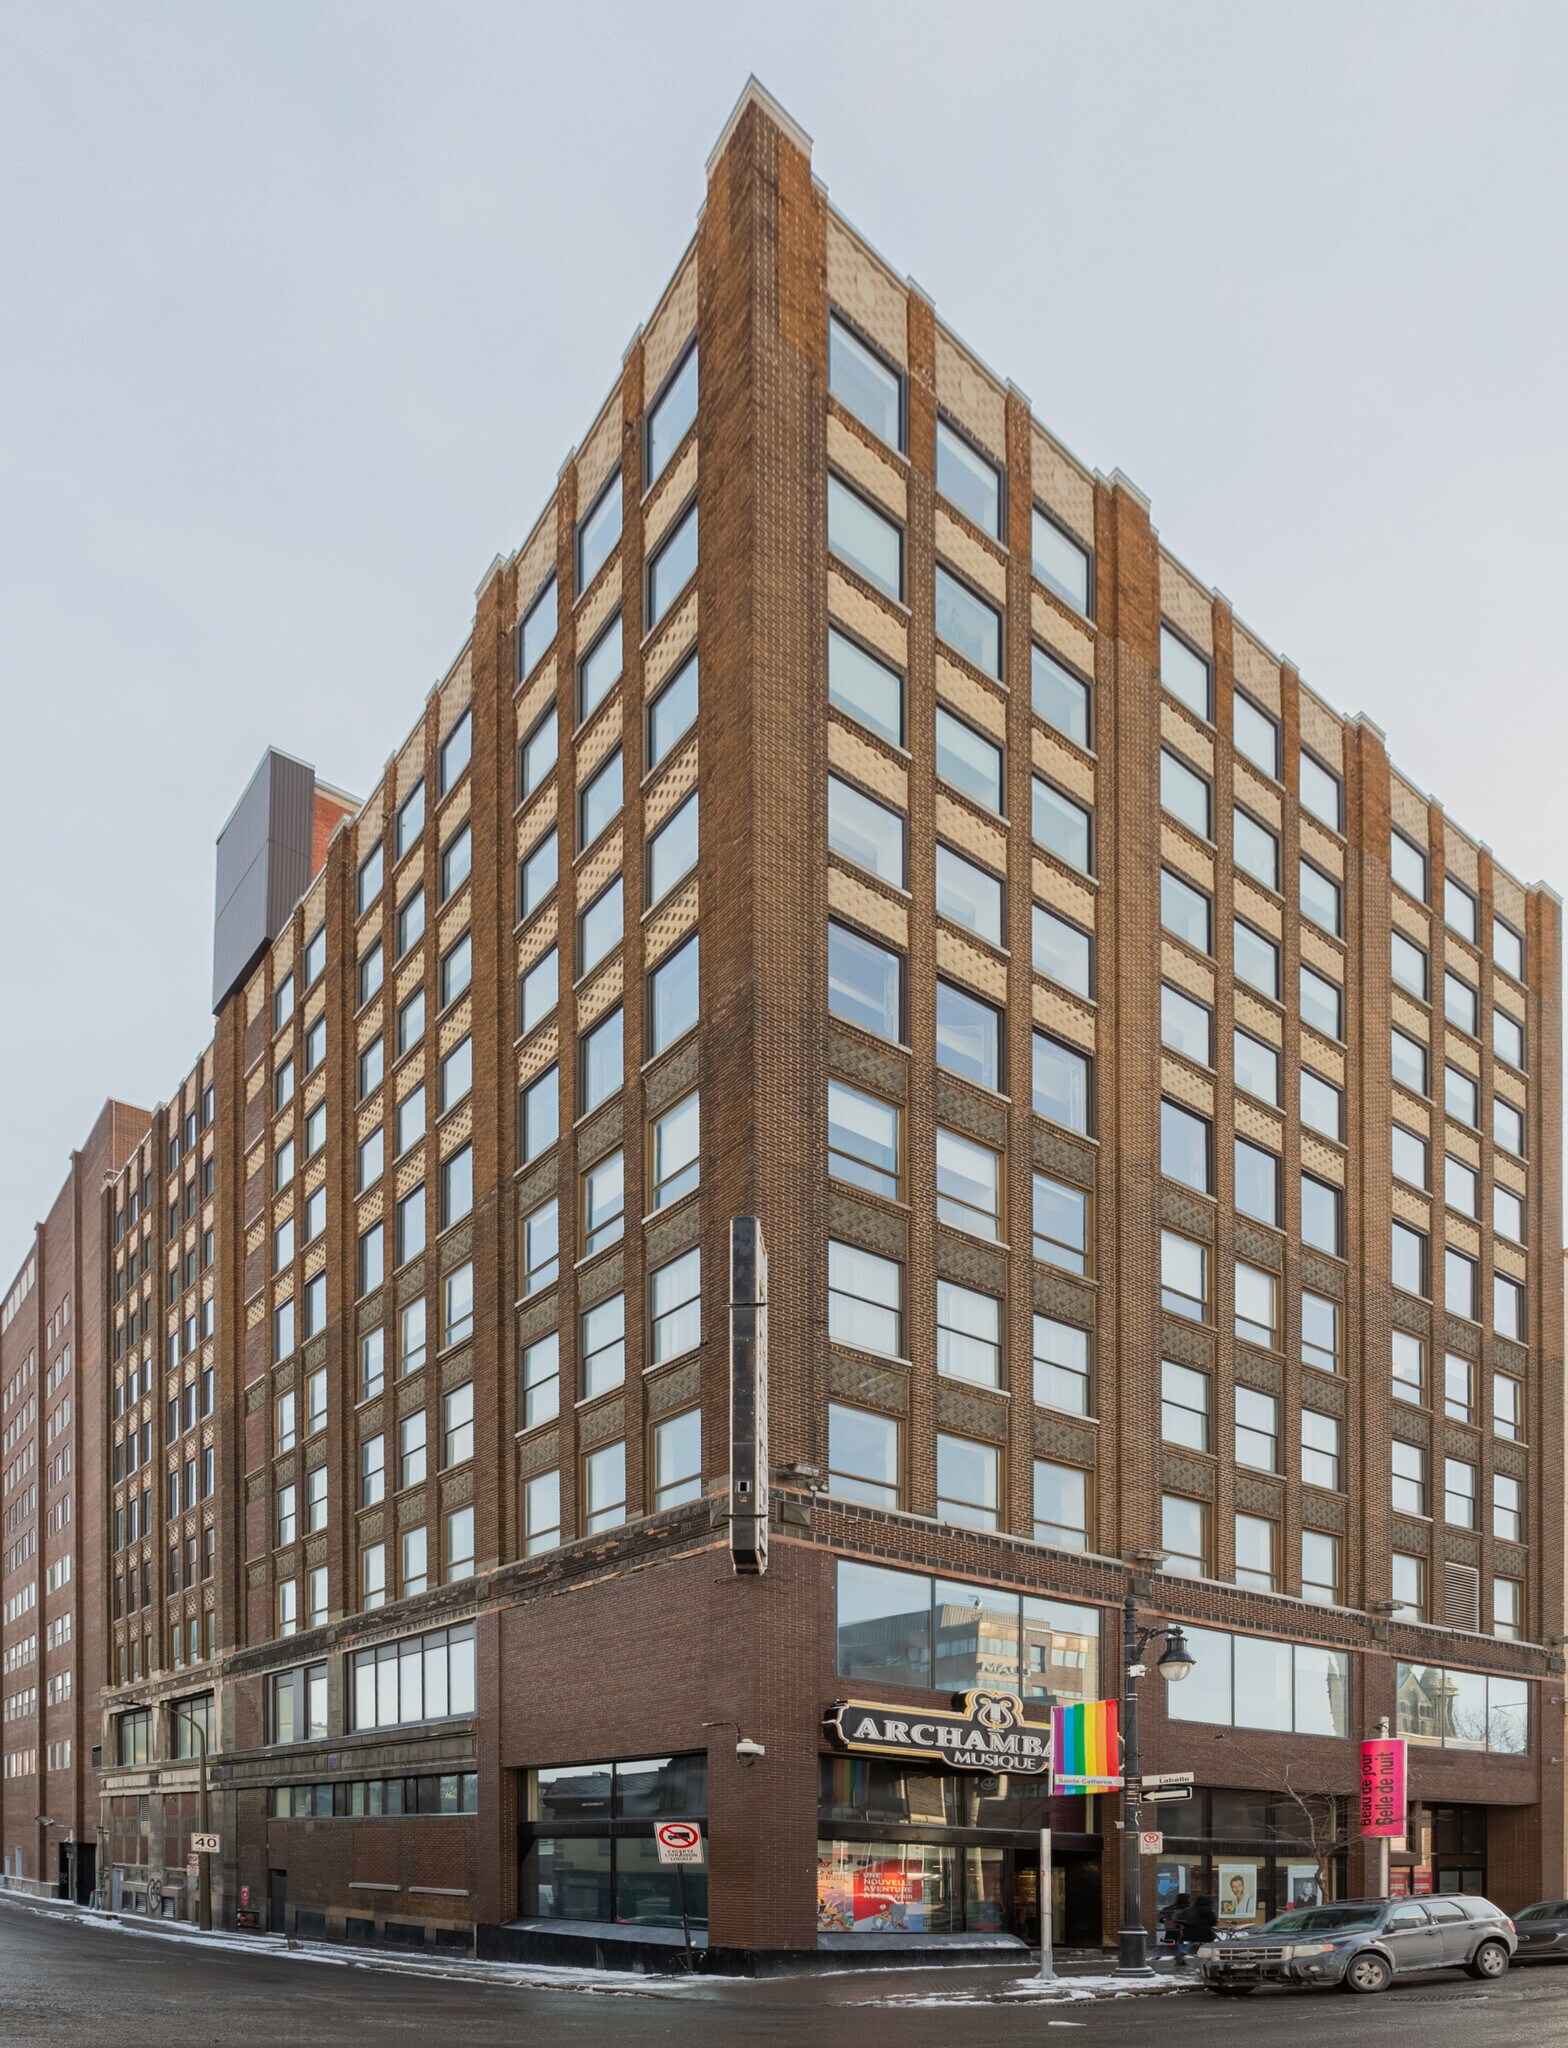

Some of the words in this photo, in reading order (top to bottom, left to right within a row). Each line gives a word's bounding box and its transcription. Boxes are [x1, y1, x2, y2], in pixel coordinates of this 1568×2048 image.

[853, 1717, 1051, 1758] ARCHAMB
[954, 1751, 1036, 1770] MUSIQUE
[1362, 1753, 1376, 1776] jour
[1374, 1752, 1394, 1775] nuit
[1159, 1776, 1190, 1784] Labelle
[1361, 1779, 1373, 1794] de
[1375, 1778, 1394, 1794] de
[1361, 1796, 1373, 1826] Beau
[1375, 1796, 1394, 1825] Belle
[195, 1838, 217, 1848] 40
